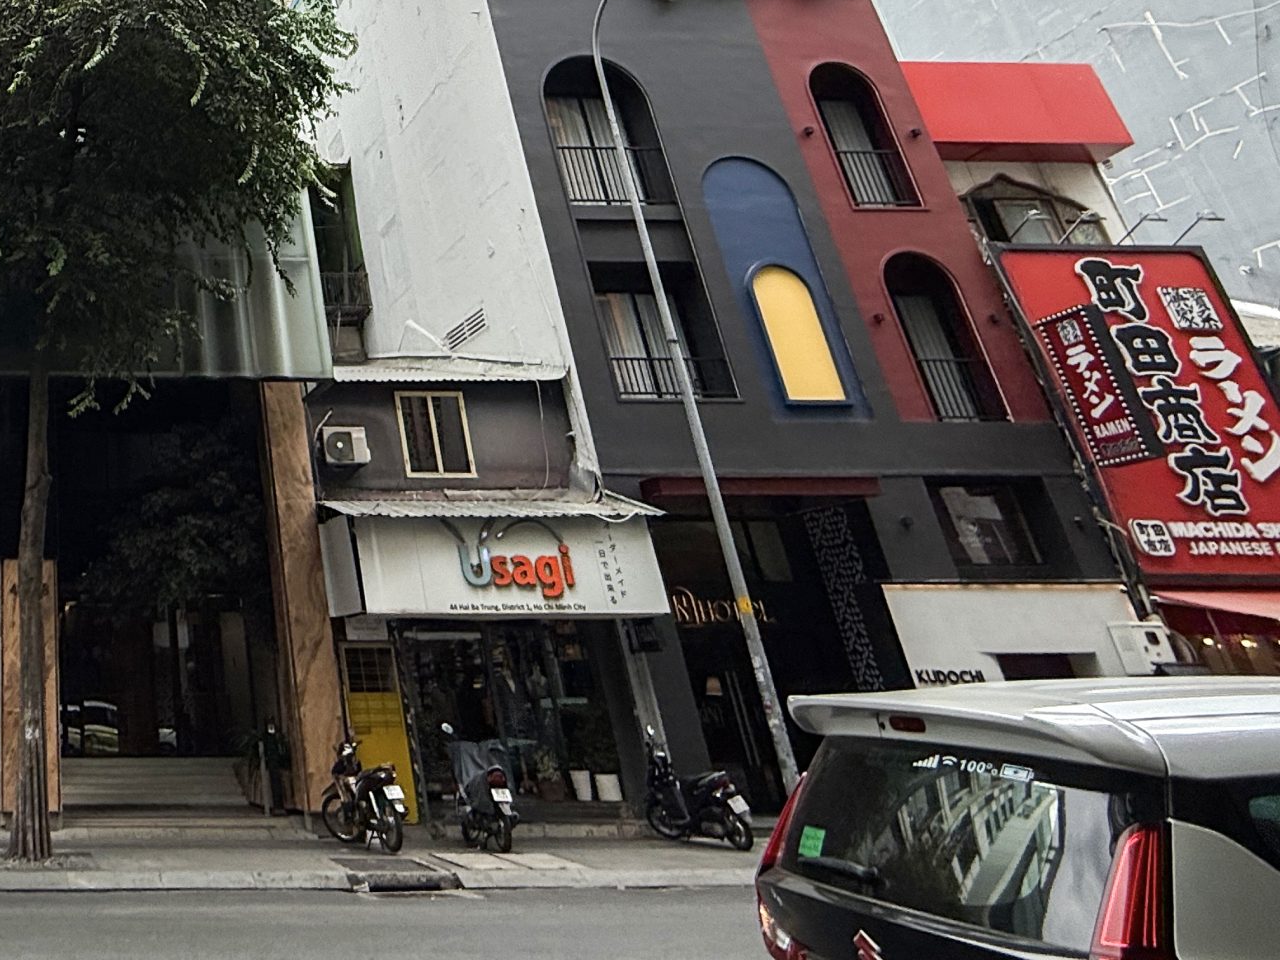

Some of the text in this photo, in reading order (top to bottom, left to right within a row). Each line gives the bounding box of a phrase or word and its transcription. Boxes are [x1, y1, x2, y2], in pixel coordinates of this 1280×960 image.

[1066, 343, 1115, 419] ラーメン
[1074, 257, 1250, 517] 町田商店
[1189, 336, 1280, 483] ラーメン
[1092, 417, 1132, 439] RAMEN
[1166, 521, 1260, 538] MACHIDA
[1189, 541, 1274, 556] JAPANESE
[457, 542, 577, 599] Usagi
[573, 603, 586, 612] City
[914, 669, 986, 685] KUDOCHI
